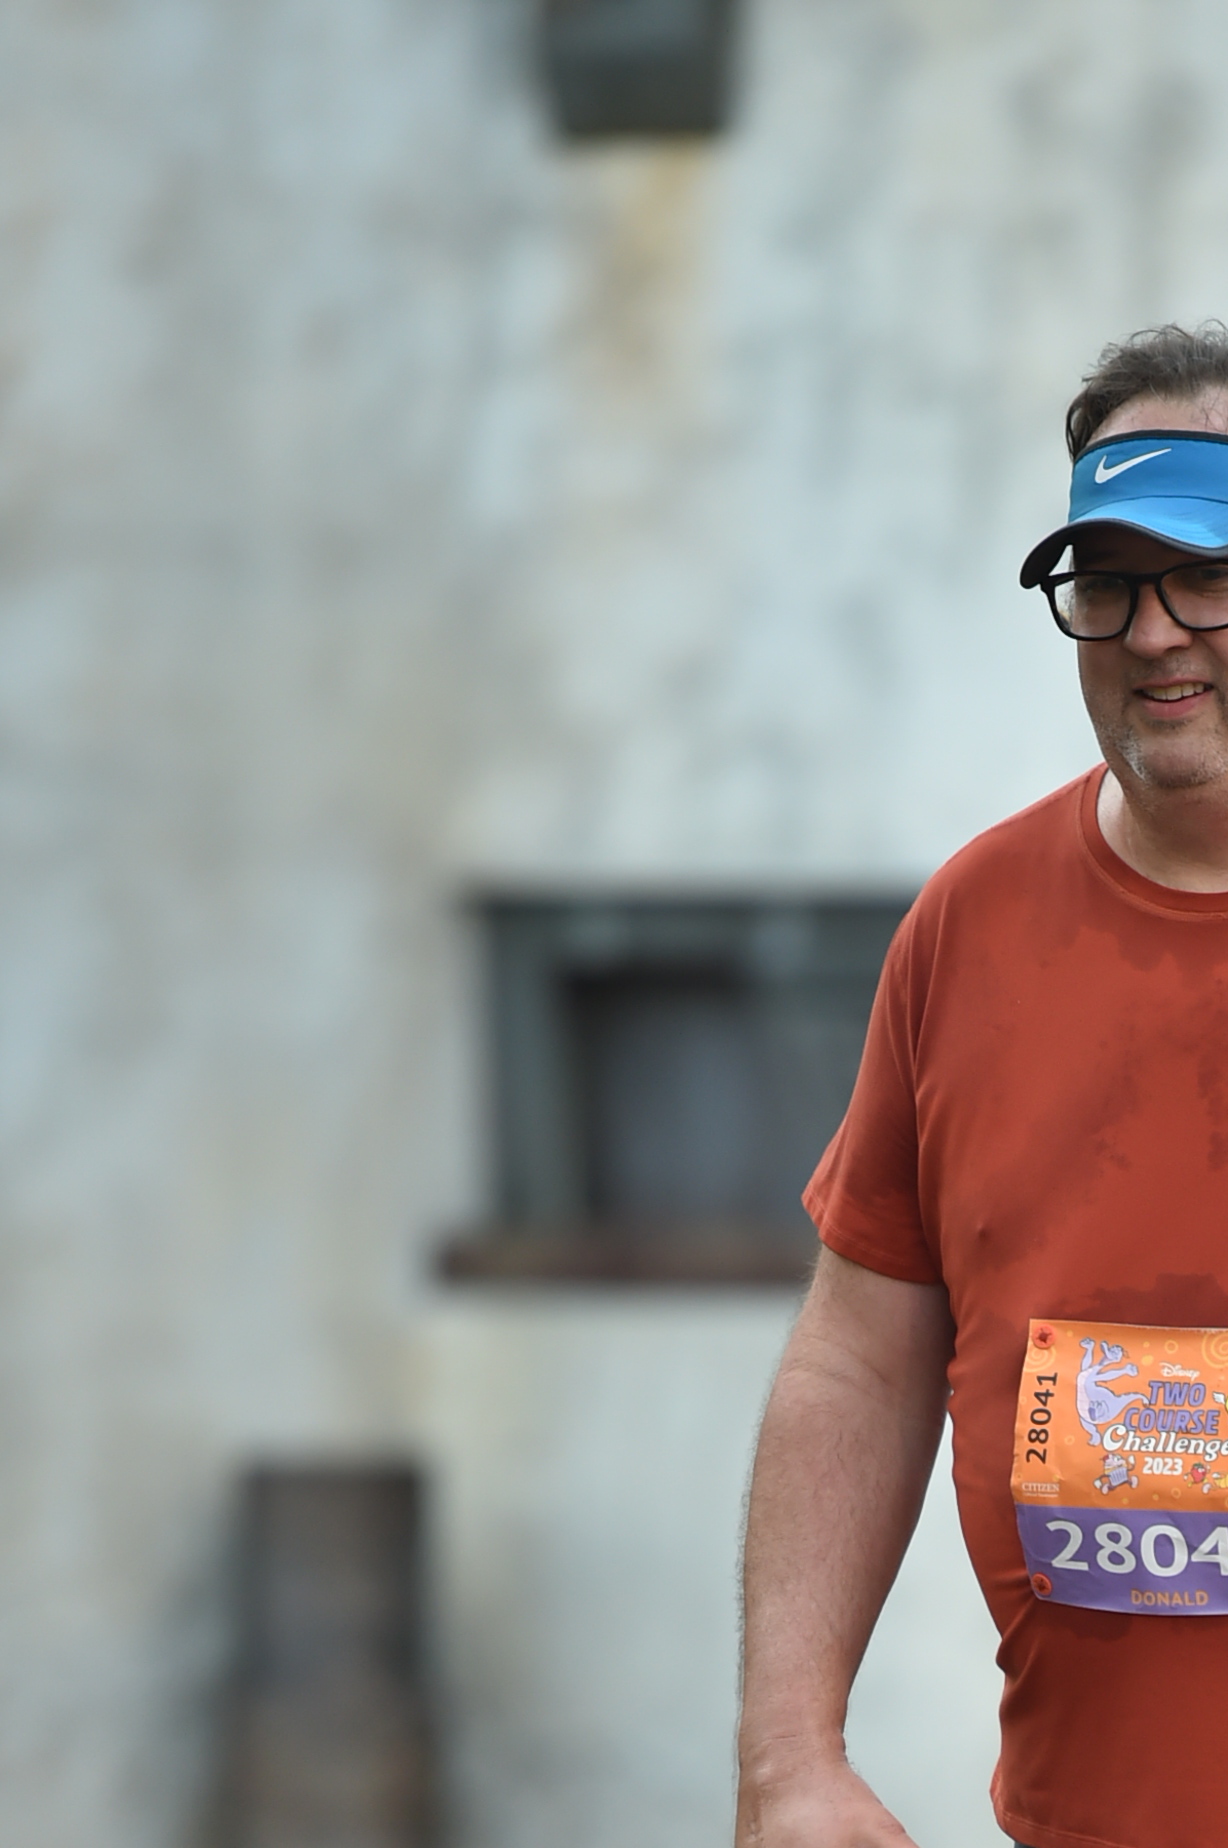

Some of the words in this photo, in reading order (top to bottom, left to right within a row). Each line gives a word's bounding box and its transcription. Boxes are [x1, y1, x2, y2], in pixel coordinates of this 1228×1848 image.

[1159, 1362, 1200, 1381] Disney
[1148, 1380, 1206, 1407] TWO
[1026, 1371, 1058, 1464] 28041
[1123, 1407, 1220, 1435] COURSE
[1142, 1457, 1183, 1475] 2023
[1022, 1482, 1060, 1492] CITIZEN
[1131, 1589, 1209, 1607] DONALD
